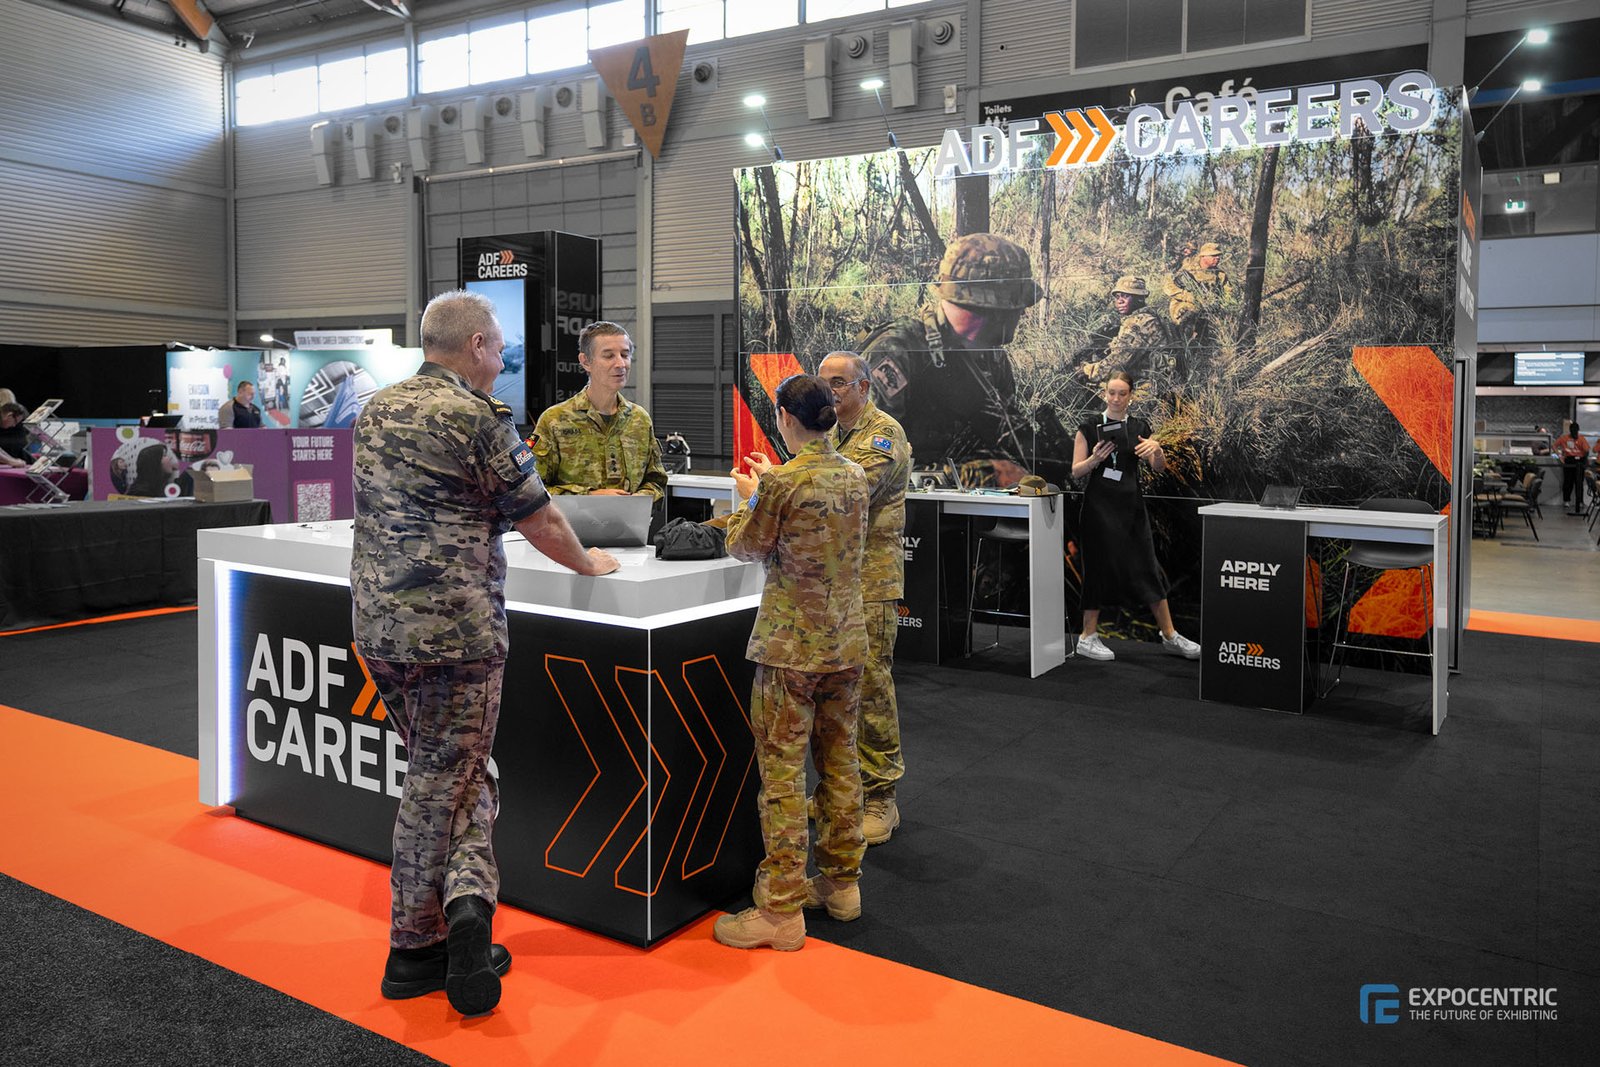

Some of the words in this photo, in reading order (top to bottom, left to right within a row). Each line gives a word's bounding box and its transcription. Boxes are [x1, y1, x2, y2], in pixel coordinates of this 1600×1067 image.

[627, 46, 661, 98] 4
[1165, 77, 1259, 120] Café
[640, 103, 657, 127] B
[984, 103, 1012, 116] Toilets
[934, 121, 1040, 177] ADF
[1125, 71, 1435, 158] CAREERS
[478, 252, 500, 266] ADF
[478, 263, 528, 279] CAREERS
[292, 436, 310, 448] YOUR
[311, 436, 335, 448] FUTURE
[292, 449, 316, 461] STARTS
[316, 449, 334, 461] HERE
[900, 536, 921, 548] PLY
[1220, 560, 1281, 576] APPLY
[1220, 575, 1270, 591] HERE
[897, 616, 922, 628] EERS
[1219, 641, 1247, 660] ADF
[1218, 652, 1281, 670] CAREERS
[246, 632, 348, 709] ADF
